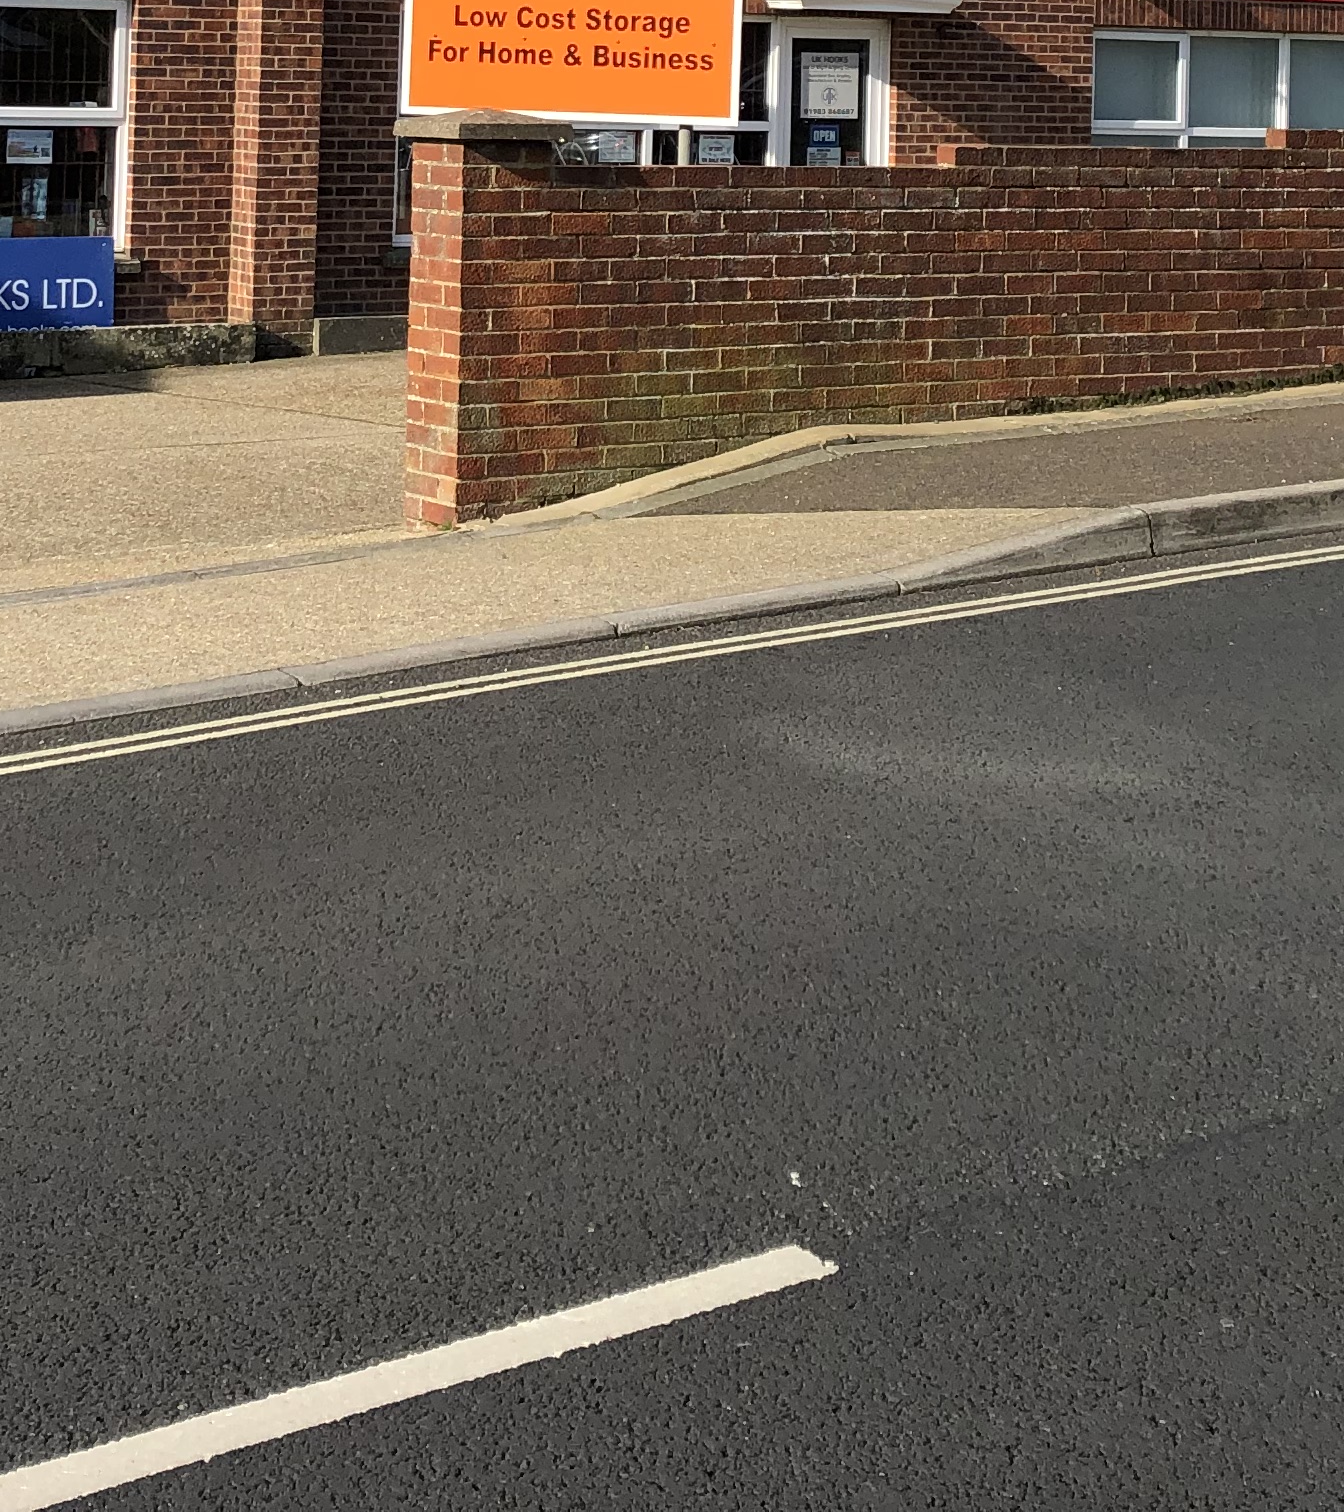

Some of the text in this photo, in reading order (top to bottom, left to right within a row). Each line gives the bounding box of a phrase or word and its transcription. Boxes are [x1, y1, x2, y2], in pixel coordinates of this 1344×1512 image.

[455, 5, 690, 38] Low Cost Storage
[428, 39, 714, 71] For Home & Business
[813, 130, 836, 142] OPEN
[43, 278, 104, 310] LTD.
